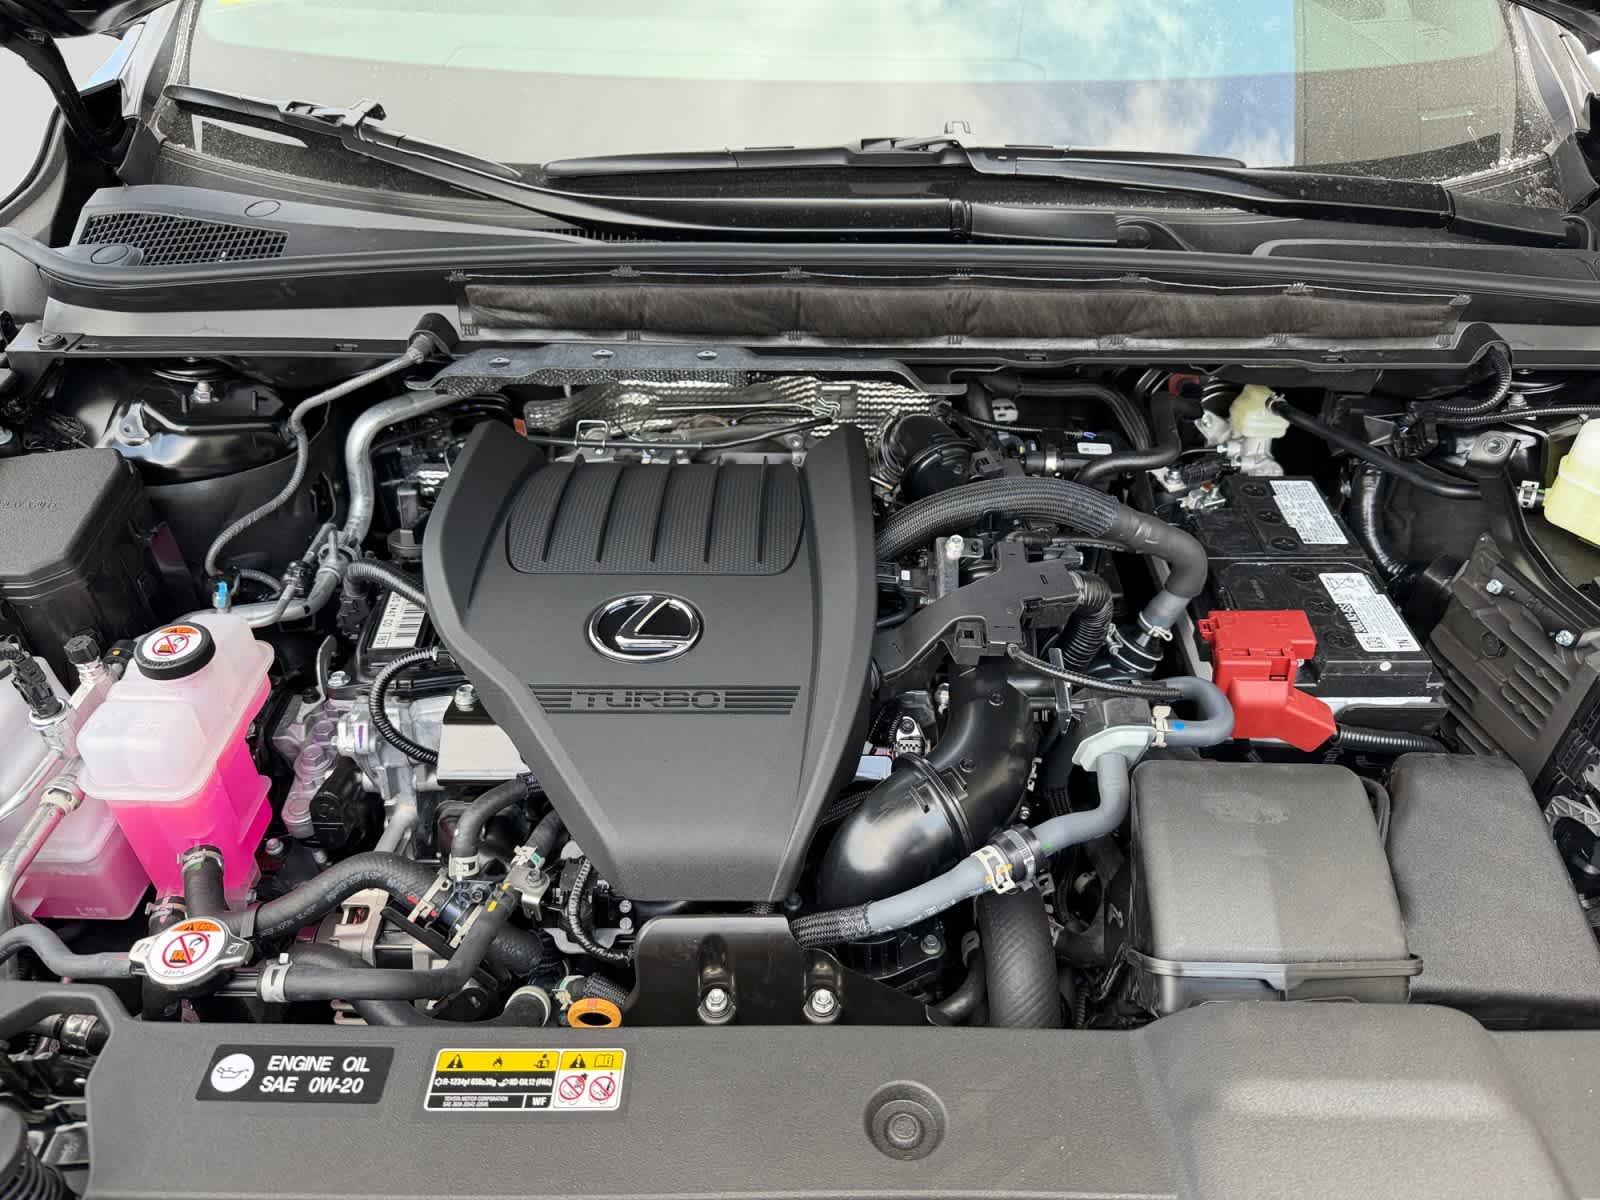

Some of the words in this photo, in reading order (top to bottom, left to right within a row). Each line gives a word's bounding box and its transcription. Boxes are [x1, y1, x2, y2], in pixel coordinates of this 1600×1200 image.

[576, 690, 721, 708] TURBO
[267, 1055, 334, 1072] ENGINE
[342, 1056, 371, 1073] OIL
[259, 1075, 299, 1093] SAE
[308, 1076, 365, 1094] 0W-20
[532, 1096, 547, 1106] WF
